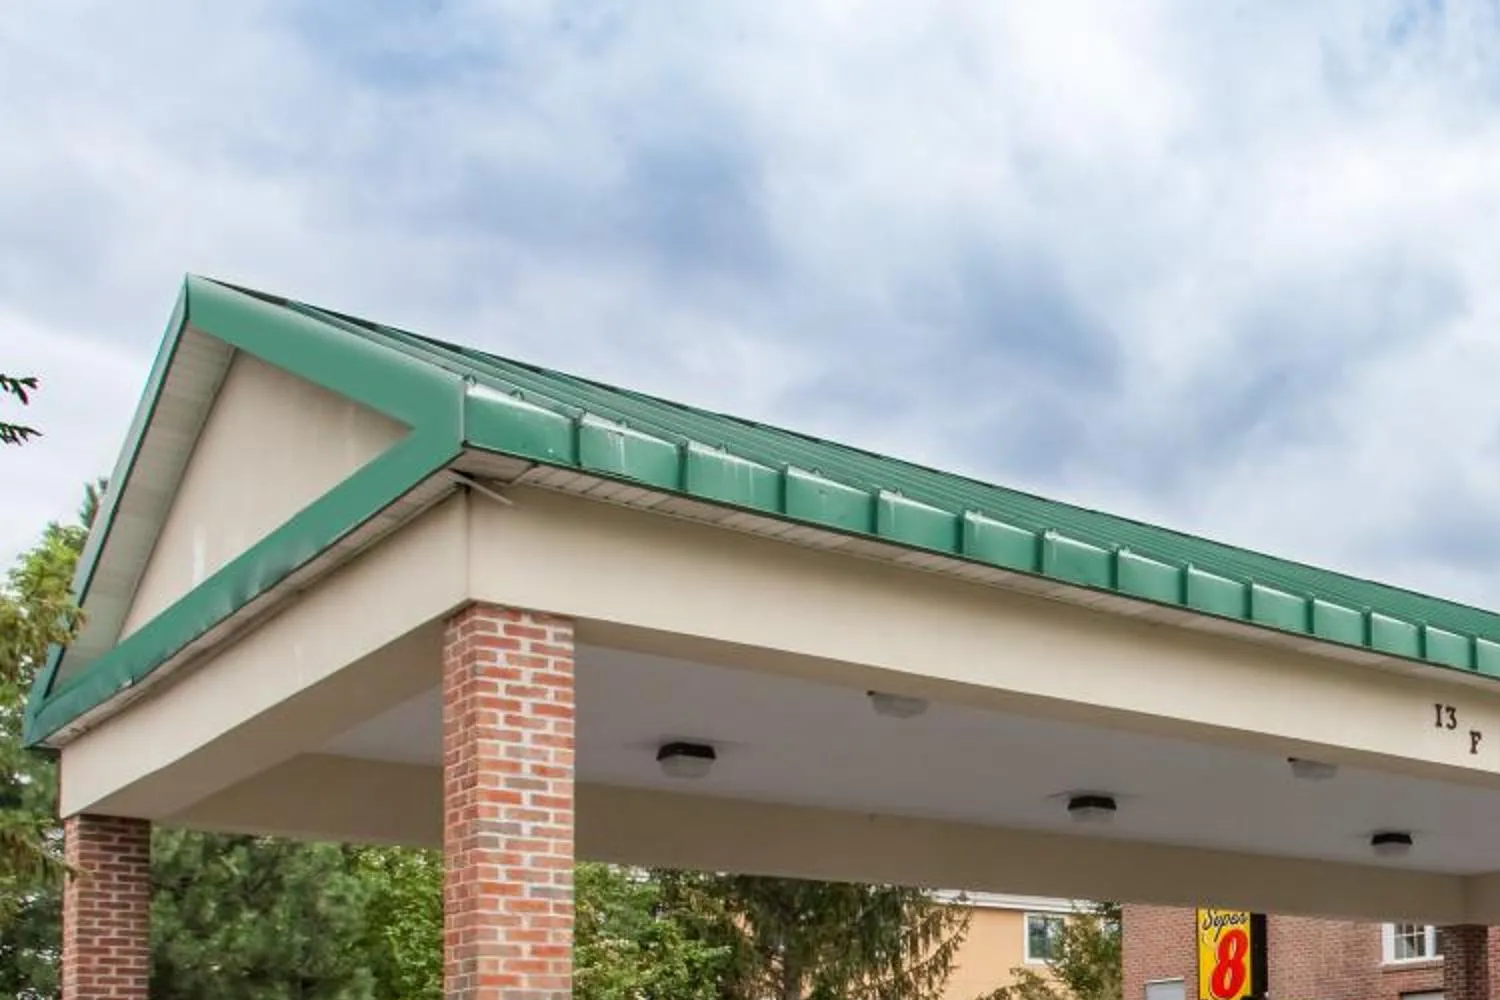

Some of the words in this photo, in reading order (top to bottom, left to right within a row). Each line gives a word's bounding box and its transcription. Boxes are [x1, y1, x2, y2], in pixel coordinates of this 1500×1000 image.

[1434, 703, 1457, 730] 13
[1202, 907, 1247, 942] Super
[1210, 929, 1249, 1000] 8
